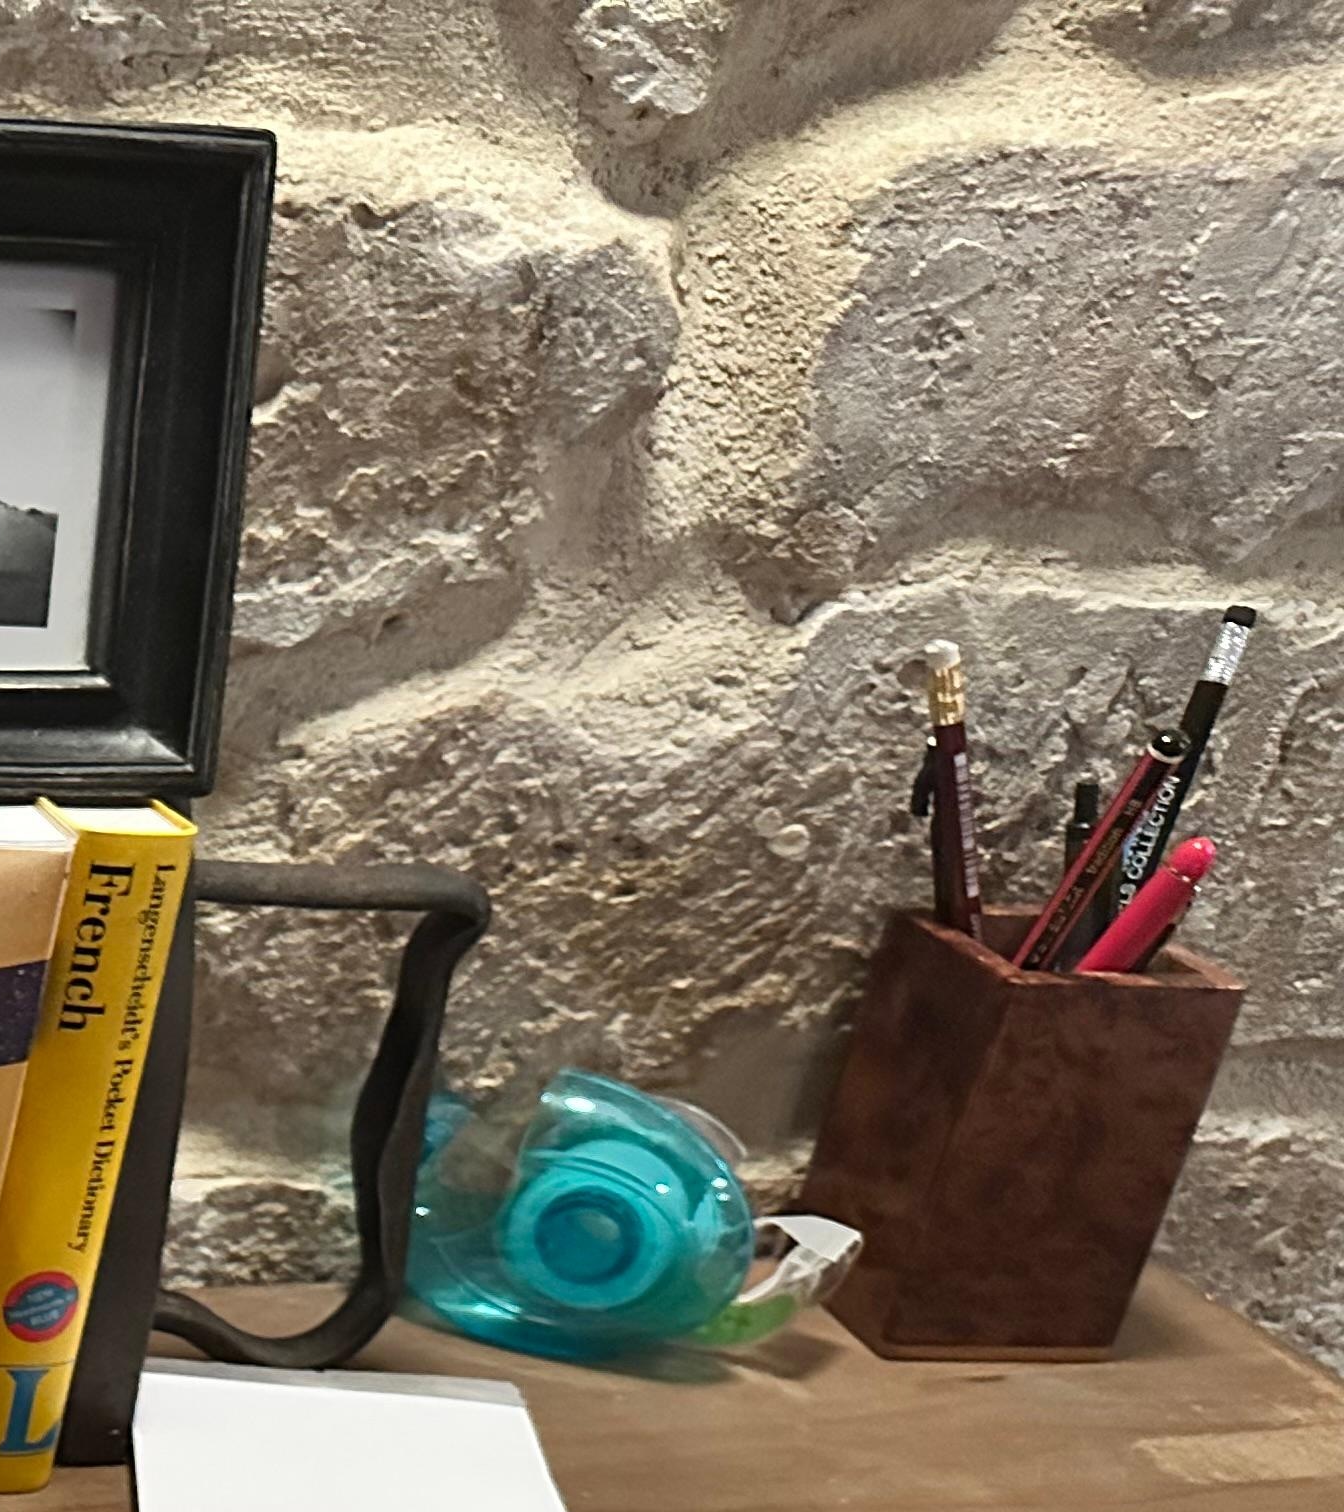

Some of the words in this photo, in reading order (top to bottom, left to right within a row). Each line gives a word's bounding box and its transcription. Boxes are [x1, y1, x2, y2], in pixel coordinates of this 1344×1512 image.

[1126, 776, 1181, 880] COLLECTION
[58, 862, 136, 1032] French
[118, 863, 177, 1052] Langenscheidt's
[99, 1059, 134, 1132] Pocket
[66, 1139, 114, 1255] Dictionary
